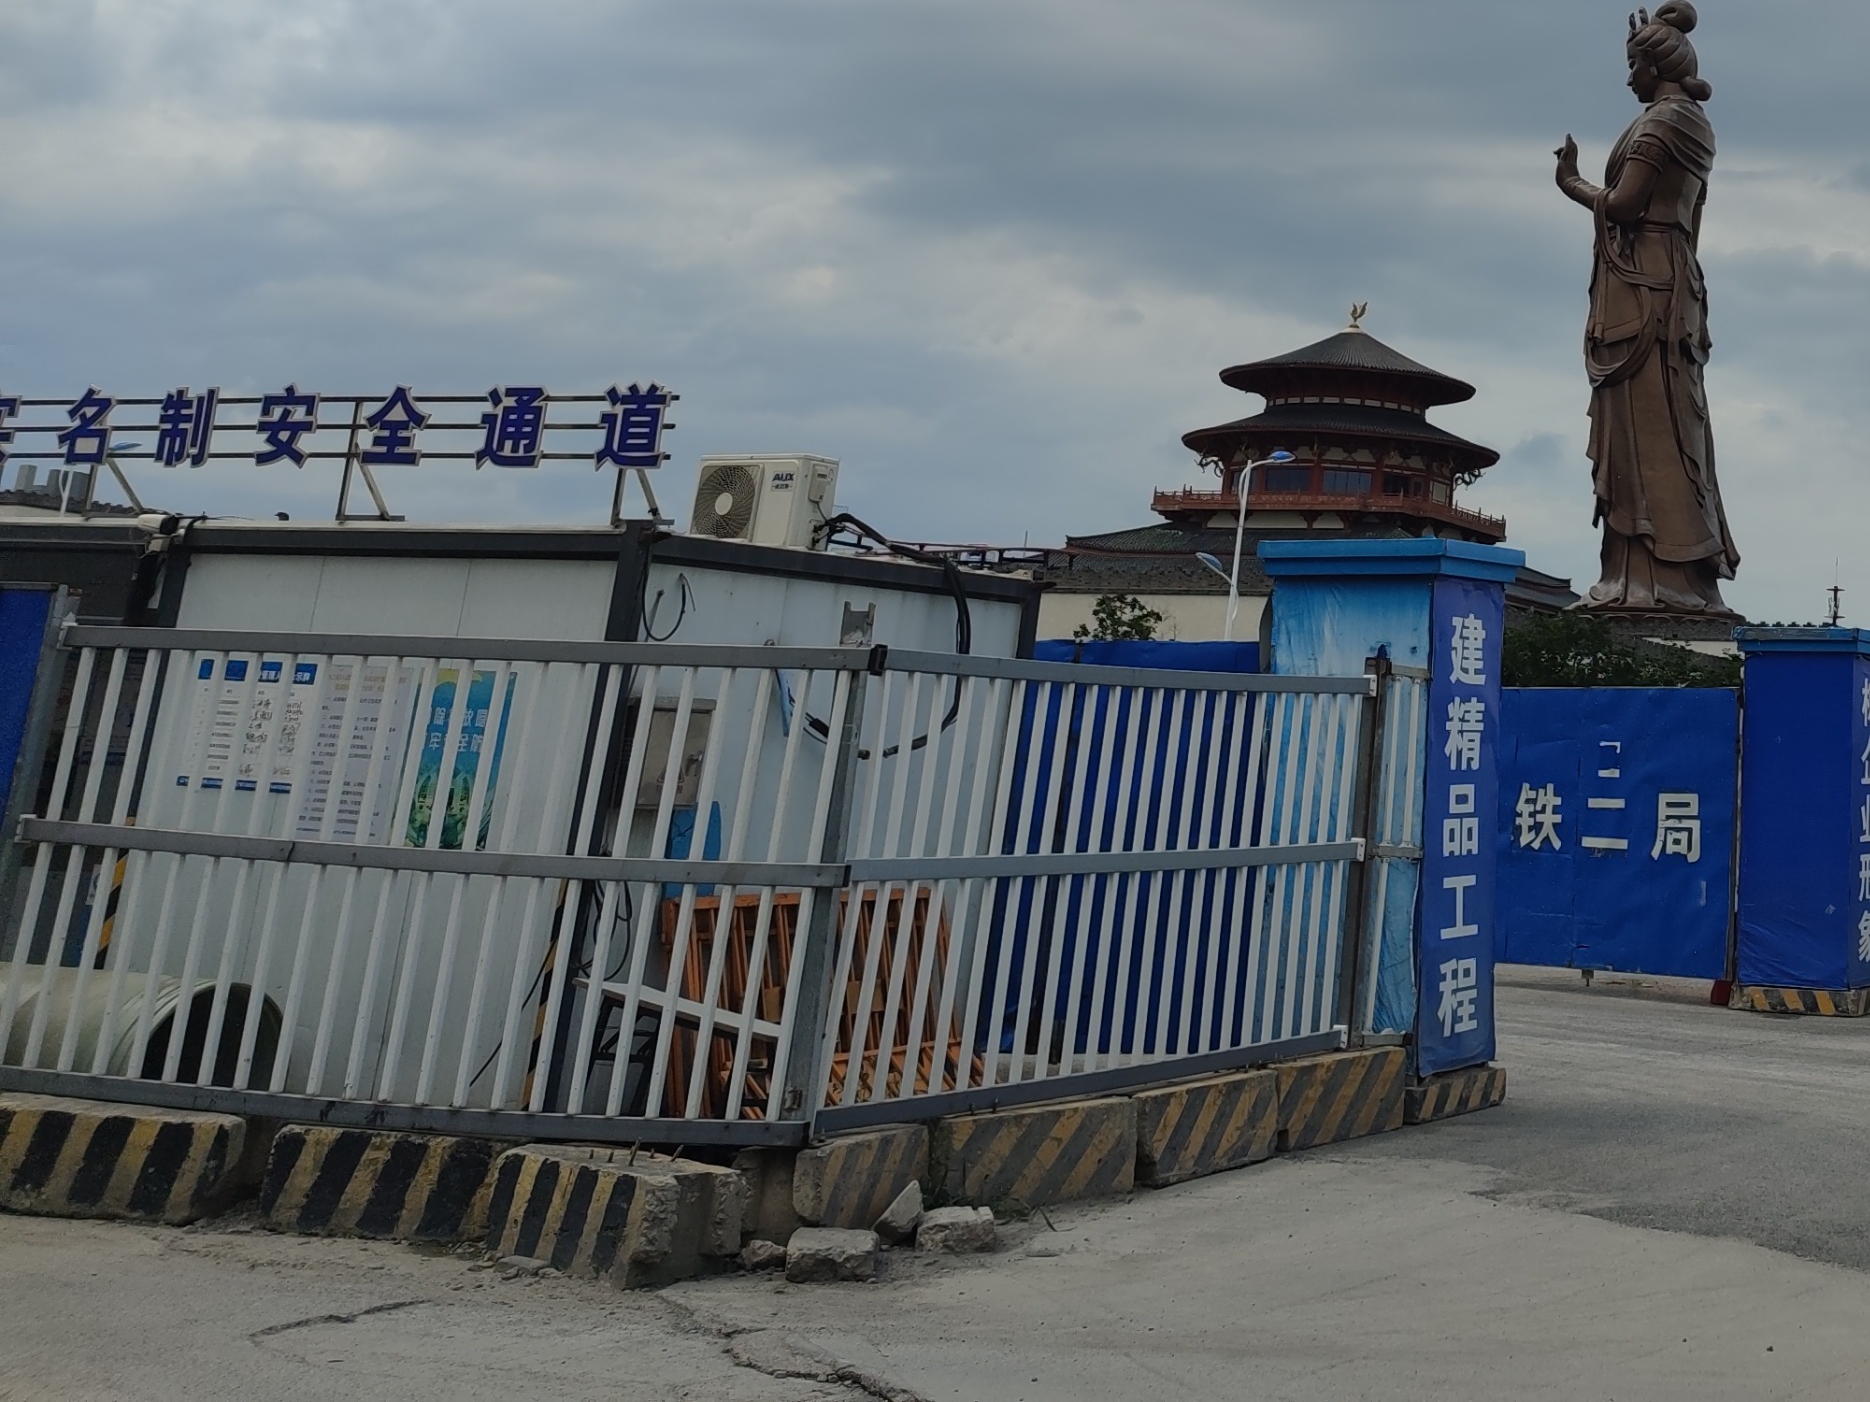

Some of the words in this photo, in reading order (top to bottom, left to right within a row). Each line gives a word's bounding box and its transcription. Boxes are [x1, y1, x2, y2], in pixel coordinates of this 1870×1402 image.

[1437, 613, 1486, 1037] 建精品工程
